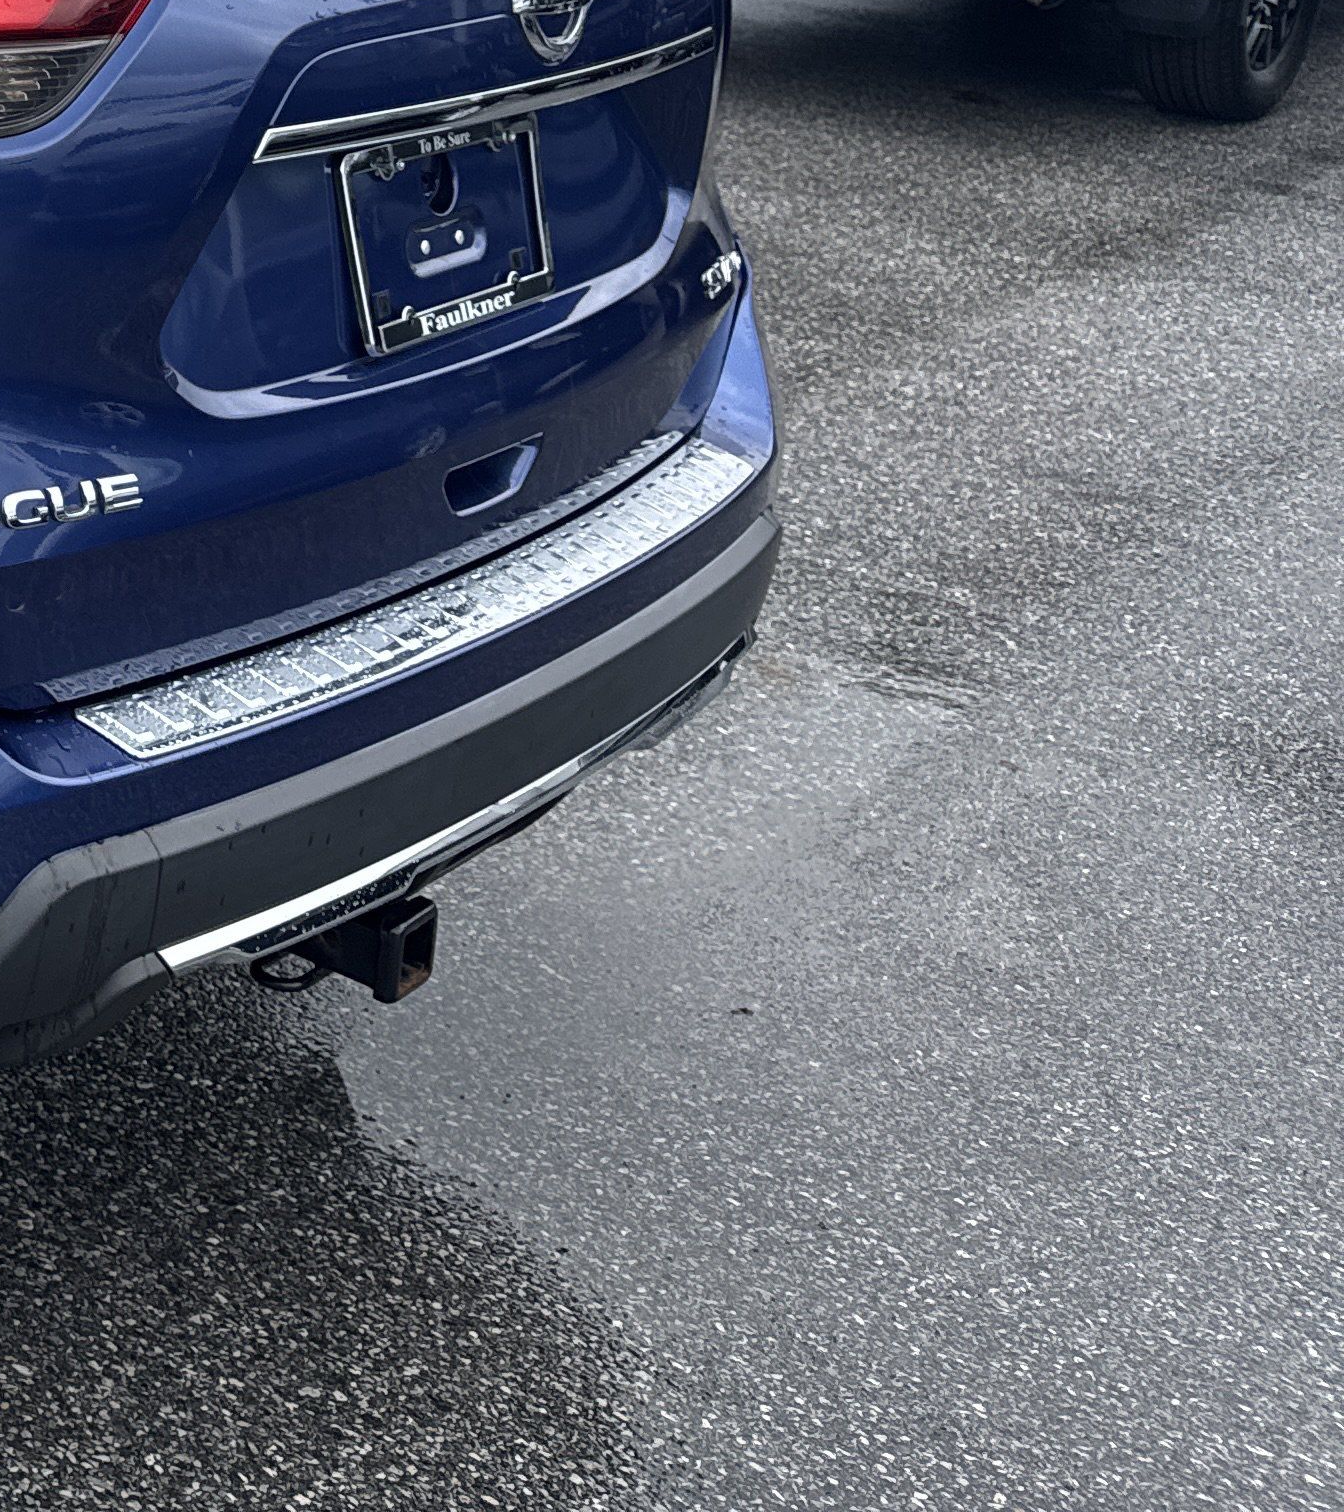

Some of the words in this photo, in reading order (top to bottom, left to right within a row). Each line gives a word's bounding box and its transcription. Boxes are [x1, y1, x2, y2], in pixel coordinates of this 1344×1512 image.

[418, 138, 432, 154] To
[433, 135, 447, 151] Be
[448, 131, 472, 147] Sure
[419, 291, 515, 337] Faulkner
